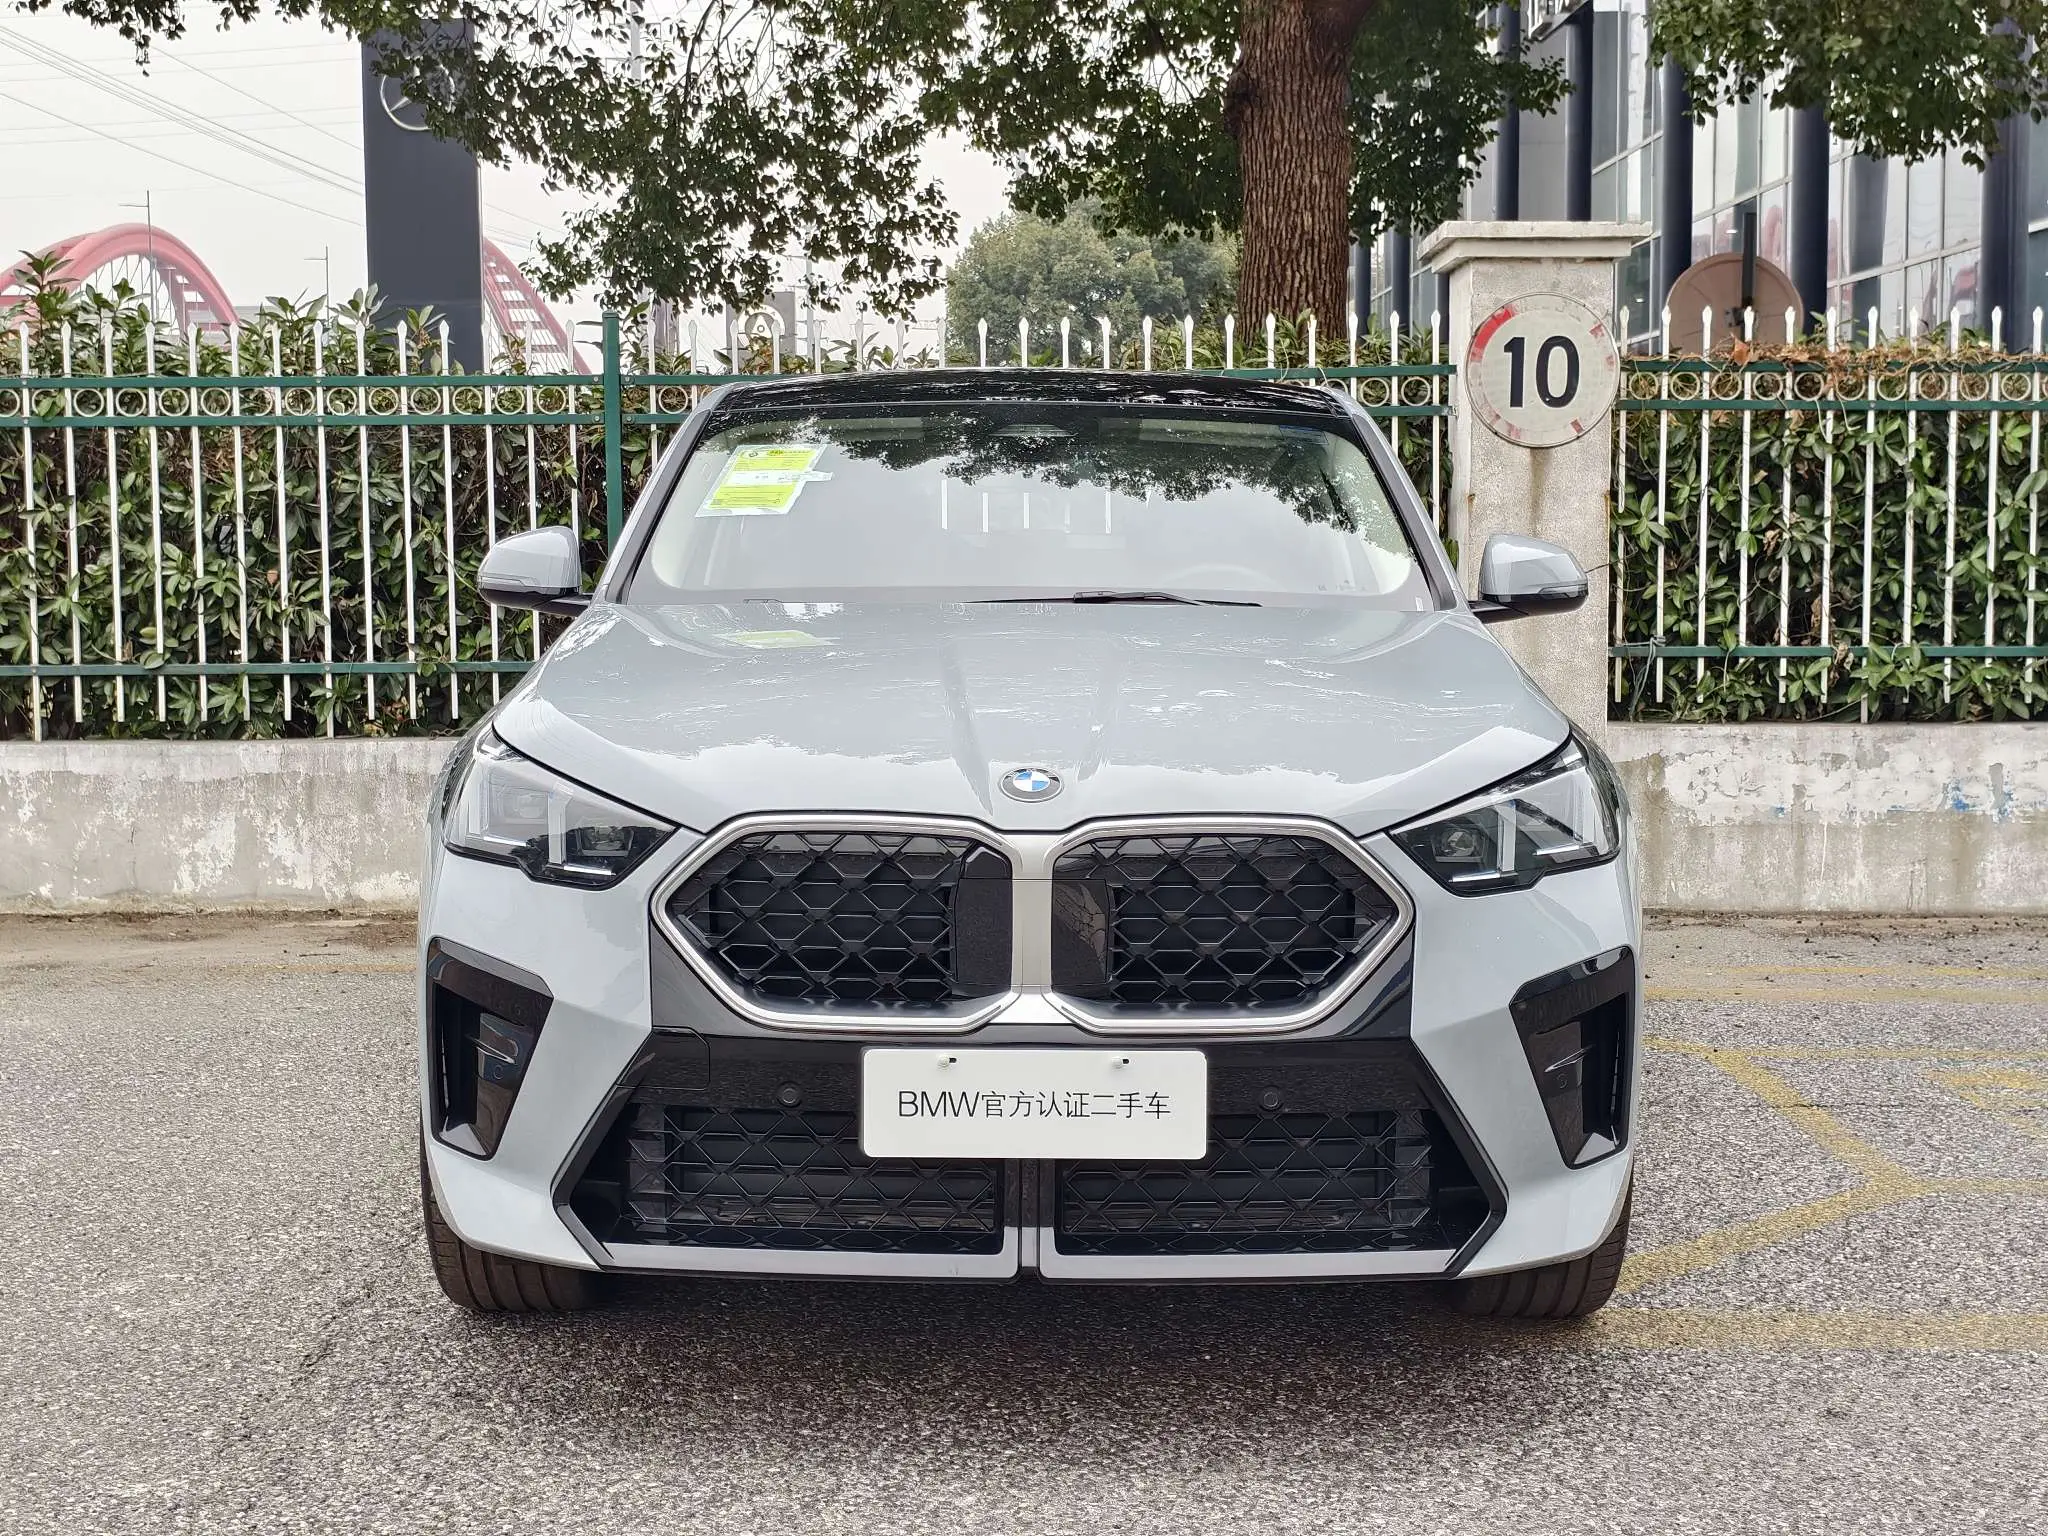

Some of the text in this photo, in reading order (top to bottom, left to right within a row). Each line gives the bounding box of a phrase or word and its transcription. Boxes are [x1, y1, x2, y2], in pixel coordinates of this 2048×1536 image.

[1503, 335, 1580, 408] 10
[898, 1090, 1171, 1120] BMW官方认证二手车
